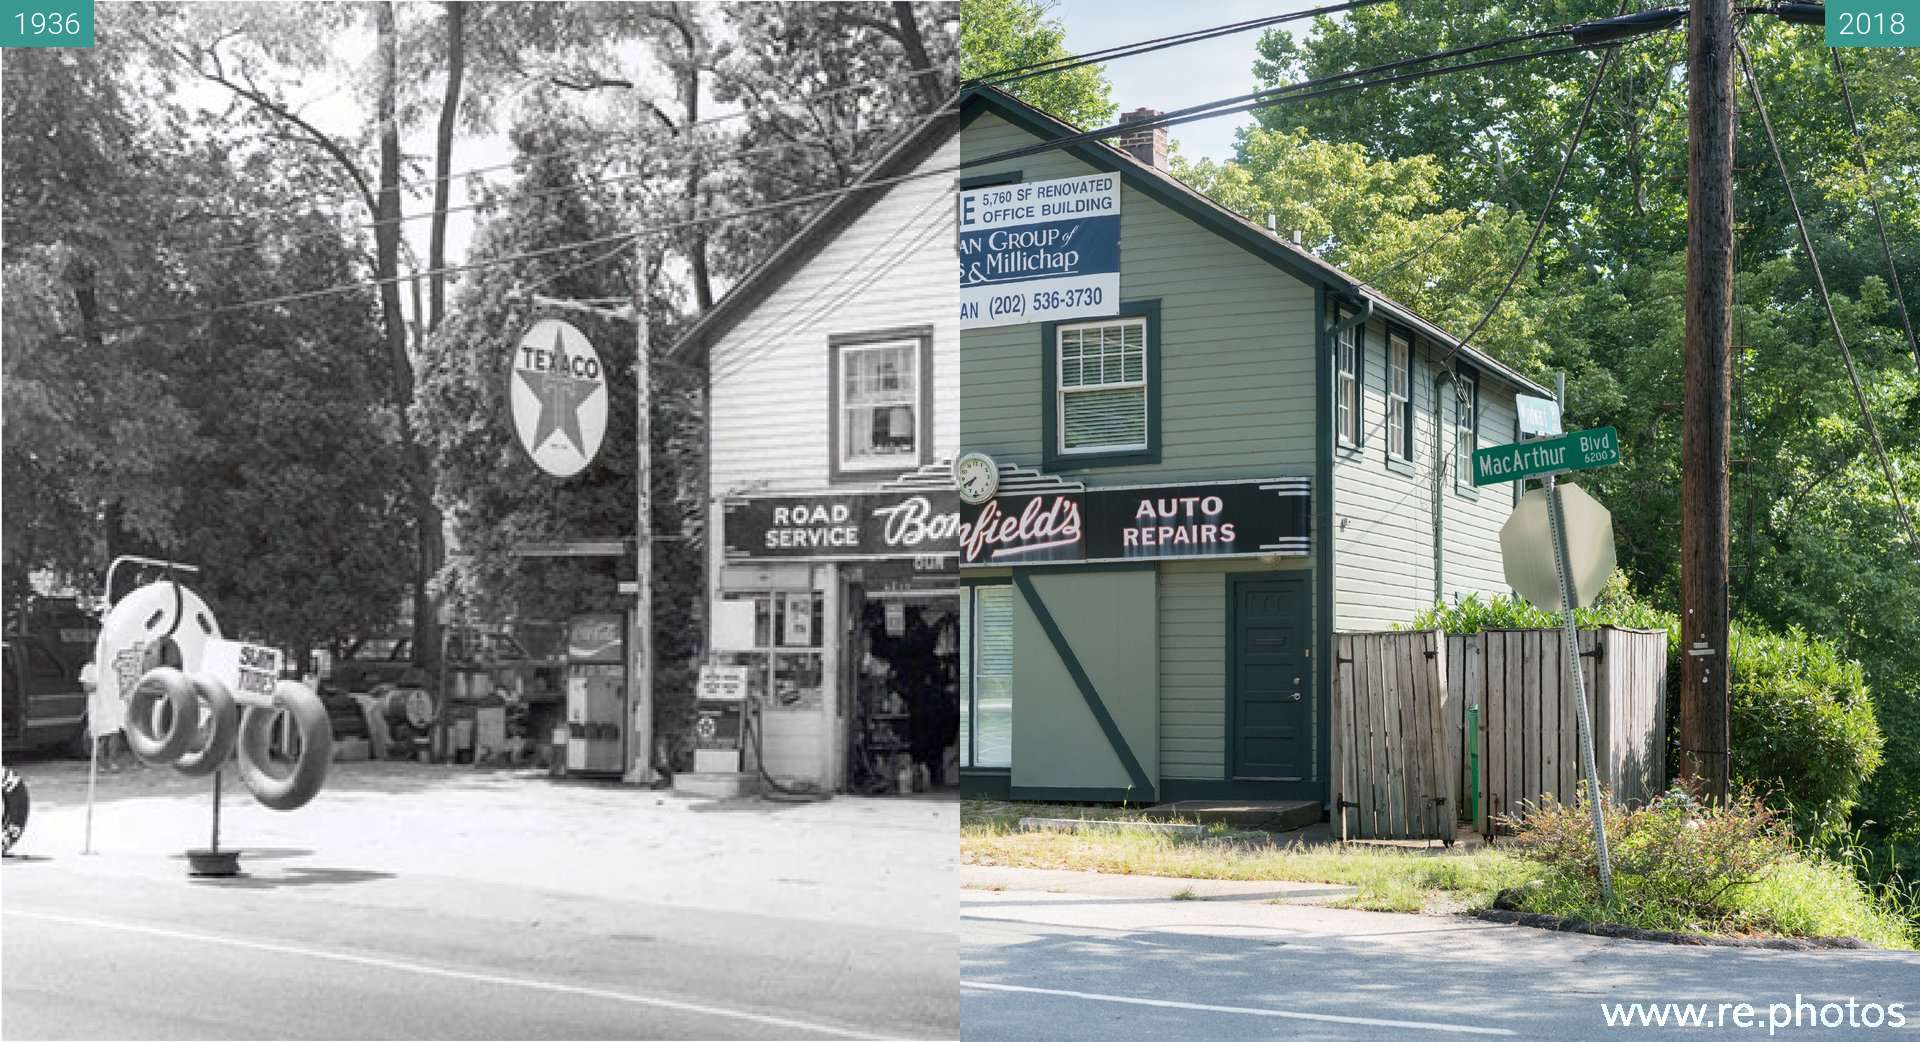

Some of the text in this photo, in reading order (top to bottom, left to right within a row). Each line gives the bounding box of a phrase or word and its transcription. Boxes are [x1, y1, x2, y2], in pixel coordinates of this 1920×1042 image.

[983, 178, 1113, 207] 5,760 SF RENOVATED
[960, 196, 975, 226] E
[983, 196, 1113, 224] OFFICE BUILDING
[988, 229, 1060, 251] GROUP
[1062, 225, 1079, 248] of
[968, 262, 988, 284] &
[986, 248, 1079, 275] Millichap
[989, 293, 1026, 320] (202)
[1033, 286, 1103, 311] 536-3730
[520, 346, 599, 379] TEXACO
[1479, 433, 1610, 478] MacArthur Blvd
[1584, 451, 1608, 464] 6200
[773, 504, 850, 526] ROAD
[1135, 496, 1224, 520] AUTO
[764, 524, 1237, 548] SERVICE REPAIRS
